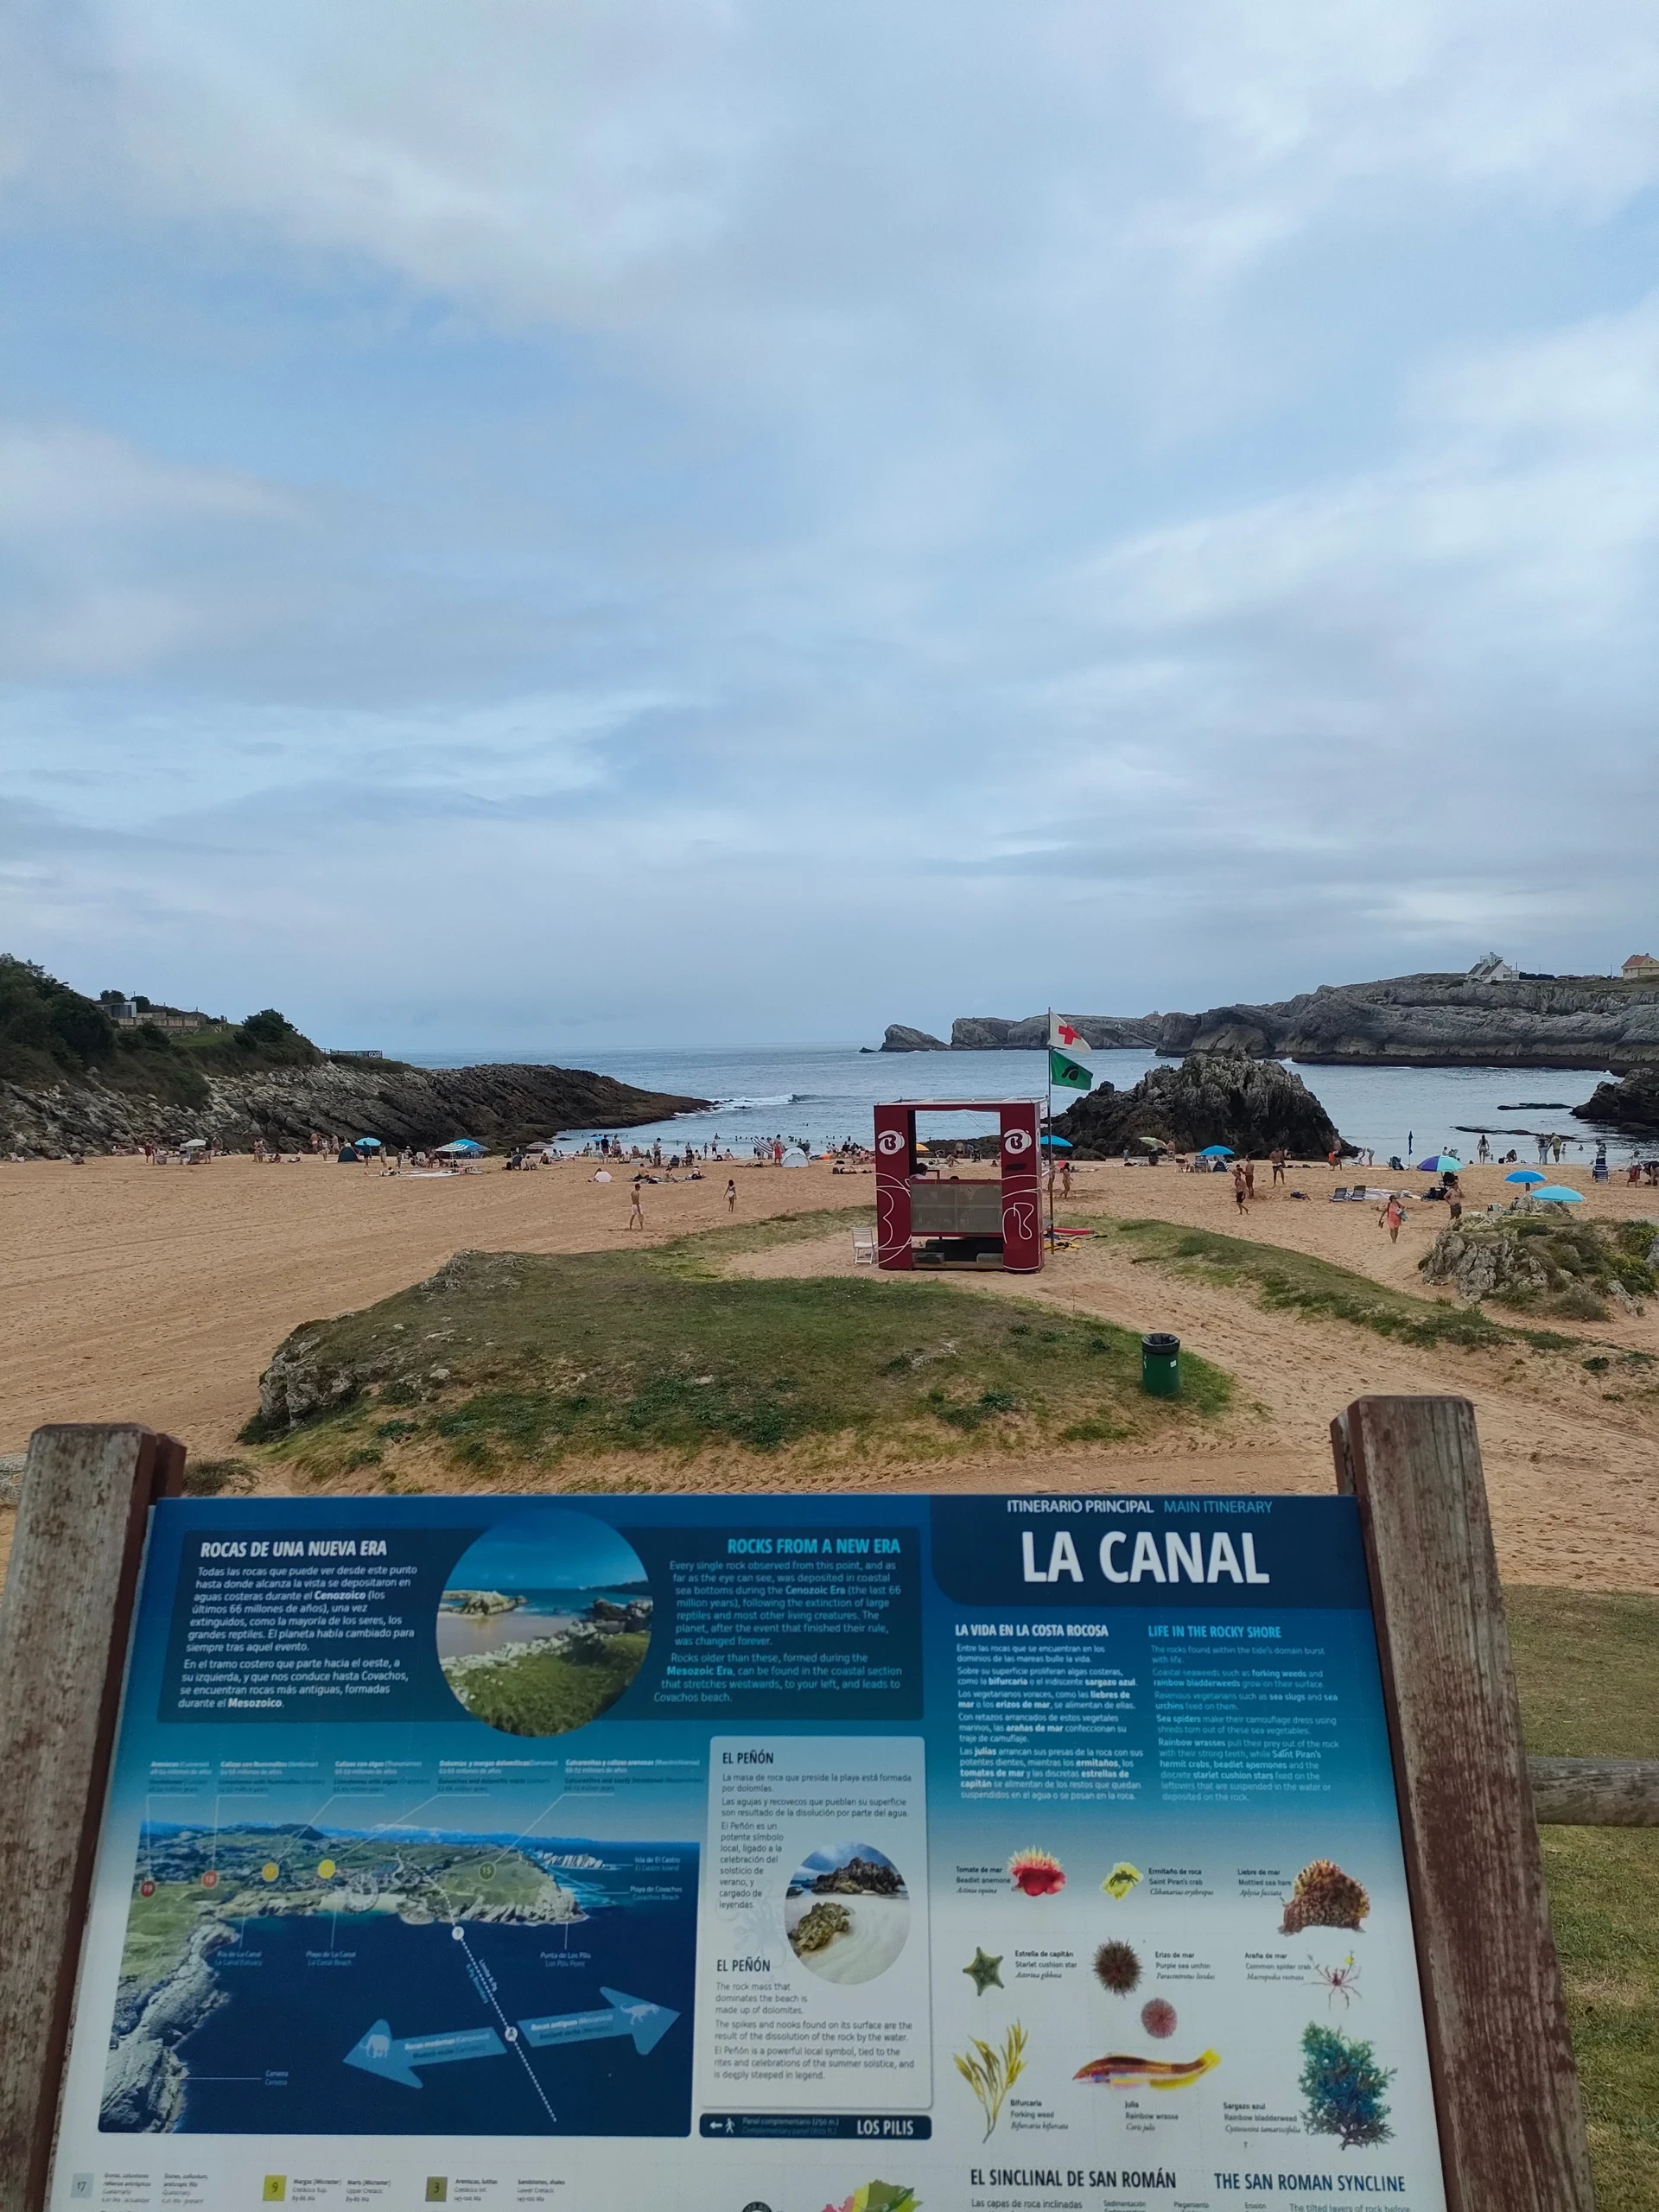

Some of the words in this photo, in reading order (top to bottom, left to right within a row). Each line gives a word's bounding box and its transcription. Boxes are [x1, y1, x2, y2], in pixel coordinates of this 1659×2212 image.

[1007, 1500, 1083, 1513] ITINERARIO
[1084, 1500, 1154, 1514] PRINCIPAL
[1164, 1500, 1200, 1514] MAIN
[1203, 1500, 1273, 1514] ITINERARY
[200, 1541, 247, 1558] ROCAS
[250, 1541, 270, 1557] DE
[272, 1541, 304, 1557] UNA
[308, 1540, 356, 1556] NUEVA
[359, 1540, 387, 1556] ERA
[728, 1539, 772, 1554] ROCKS
[776, 1538, 817, 1554] FROM
[821, 1538, 832, 1554] A
[836, 1538, 870, 1554] NEW
[873, 1538, 901, 1554] ERA
[1022, 1531, 1084, 1583] LA
[1099, 1531, 1270, 1584] CANAL
[198, 1567, 225, 1577] Todas
[226, 1566, 240, 1576] las
[268, 1568, 288, 1578] que
[288, 1565, 319, 1578] puede
[336, 1565, 366, 1575] desde
[366, 1565, 388, 1575] este
[389, 1564, 417, 1577] punto
[670, 1560, 695, 1573] Every
[696, 1560, 724, 1573] single
[725, 1560, 746, 1570] rock
[747, 1560, 791, 1570] observed
[791, 1560, 814, 1570] from
[815, 1560, 834, 1570] this
[835, 1560, 863, 1572] point,
[864, 1560, 883, 1570] and
[195, 1579, 222, 1589] hasta
[223, 1578, 254, 1588] donde
[255, 1578, 291, 1588] alcanza
[292, 1578, 302, 1588] la
[303, 1578, 326, 1588] vista
[340, 1577, 397, 1590] depositaron
[194, 1593, 222, 1604] aguas
[224, 1591, 264, 1601] costeras
[264, 1590, 302, 1600] durante
[303, 1590, 313, 1600] el
[314, 1589, 366, 1600] Cenozoico
[367, 1589, 385, 1602] (los
[693, 1585, 734, 1595] bottoms
[734, 1585, 766, 1597] during
[766, 1585, 783, 1595] the
[785, 1585, 828, 1595] Cenozoic
[829, 1585, 846, 1595] Era
[847, 1585, 867, 1597] (the
[868, 1585, 886, 1595] last
[887, 1585, 901, 1595] 66
[955, 1624, 969, 1637] LA
[969, 1624, 997, 1637] VIDA
[998, 1624, 1014, 1637] EN
[1015, 1624, 1030, 1637] LA
[1031, 1624, 1065, 1637] COSTA
[1066, 1624, 1109, 1637] ROCOSA
[1148, 1625, 1169, 1637] LIFE
[1172, 1625, 1185, 1637] IN
[1186, 1625, 1207, 1637] THE
[1209, 1625, 1243, 1638] ROCKY
[1246, 1626, 1281, 1638] SHORE
[178, 1698, 215, 1708] durante
[216, 1698, 226, 1707] el
[227, 1697, 284, 1707] Mesozoico.
[653, 1692, 698, 1702] Covachos
[700, 1692, 732, 1702] beach.
[722, 1752, 734, 1764] EL
[736, 1750, 773, 1764] PEÑÓN
[722, 1773, 732, 1782] La
[755, 1773, 765, 1782] de
[785, 1775, 799, 1784] que
[801, 1773, 830, 1784] preside
[830, 1773, 838, 1782] la
[839, 1773, 860, 1784] playa
[879, 1773, 912, 1782] formada
[721, 1786, 734, 1795] por
[716, 1960, 728, 1973] EL
[732, 1957, 771, 1973] PEÑÓN
[716, 1981, 730, 1991] The
[732, 1981, 749, 1991] rock
[773, 1981, 791, 1991] that
[715, 1993, 758, 2003] dominates
[759, 1993, 772, 2003] the
[774, 1993, 799, 2003] beach
[800, 1993, 808, 2003] is
[715, 2005, 738, 2014] made
[740, 2007, 750, 2017] up
[752, 2005, 760, 2014] of
[761, 2005, 804, 2014] dolomites.
[857, 2120, 880, 2135] LOS
[882, 2120, 914, 2135] PILIS
[971, 2169, 985, 2185] EL
[989, 2170, 1062, 2187] SINCLINAL
[1066, 2171, 1084, 2187] DE
[1089, 2171, 1116, 2188] SAN
[1122, 2167, 1176, 2189] ROMÁN
[1214, 2172, 1240, 2190] THE
[1244, 2173, 1273, 2190] SAN
[1278, 2174, 1332, 2191] ROMAN
[1337, 2175, 1406, 2192] SYNCLINE
